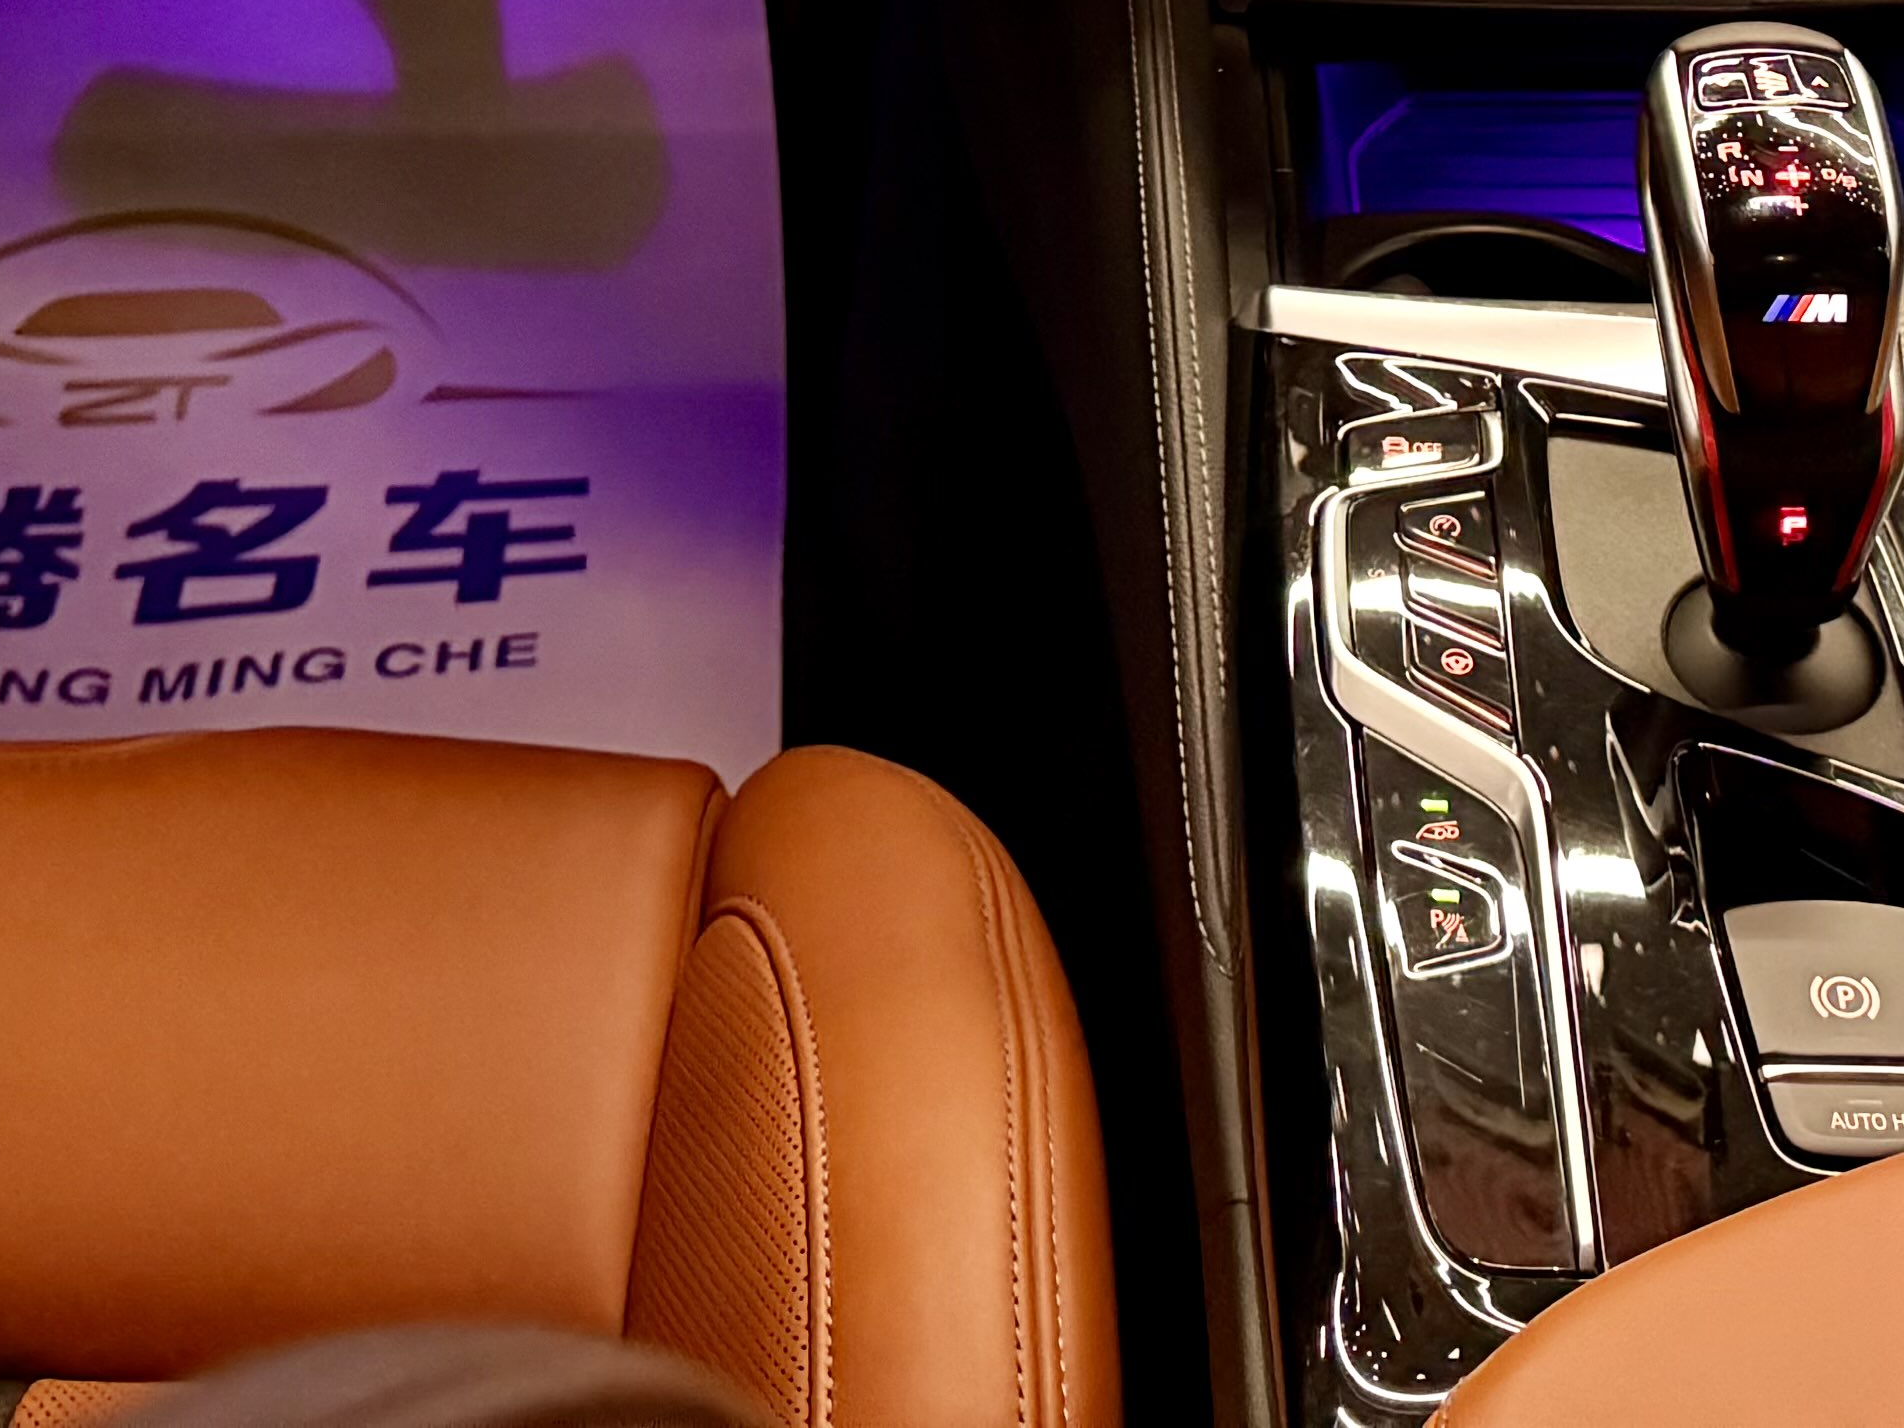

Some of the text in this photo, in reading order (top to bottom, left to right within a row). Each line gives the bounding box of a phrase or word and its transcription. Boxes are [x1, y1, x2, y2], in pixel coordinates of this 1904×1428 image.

[1717, 141, 1742, 162] R
[136, 644, 348, 705] MING
[372, 631, 542, 677] CHE
[1830, 1111, 1888, 1131] AUTO
